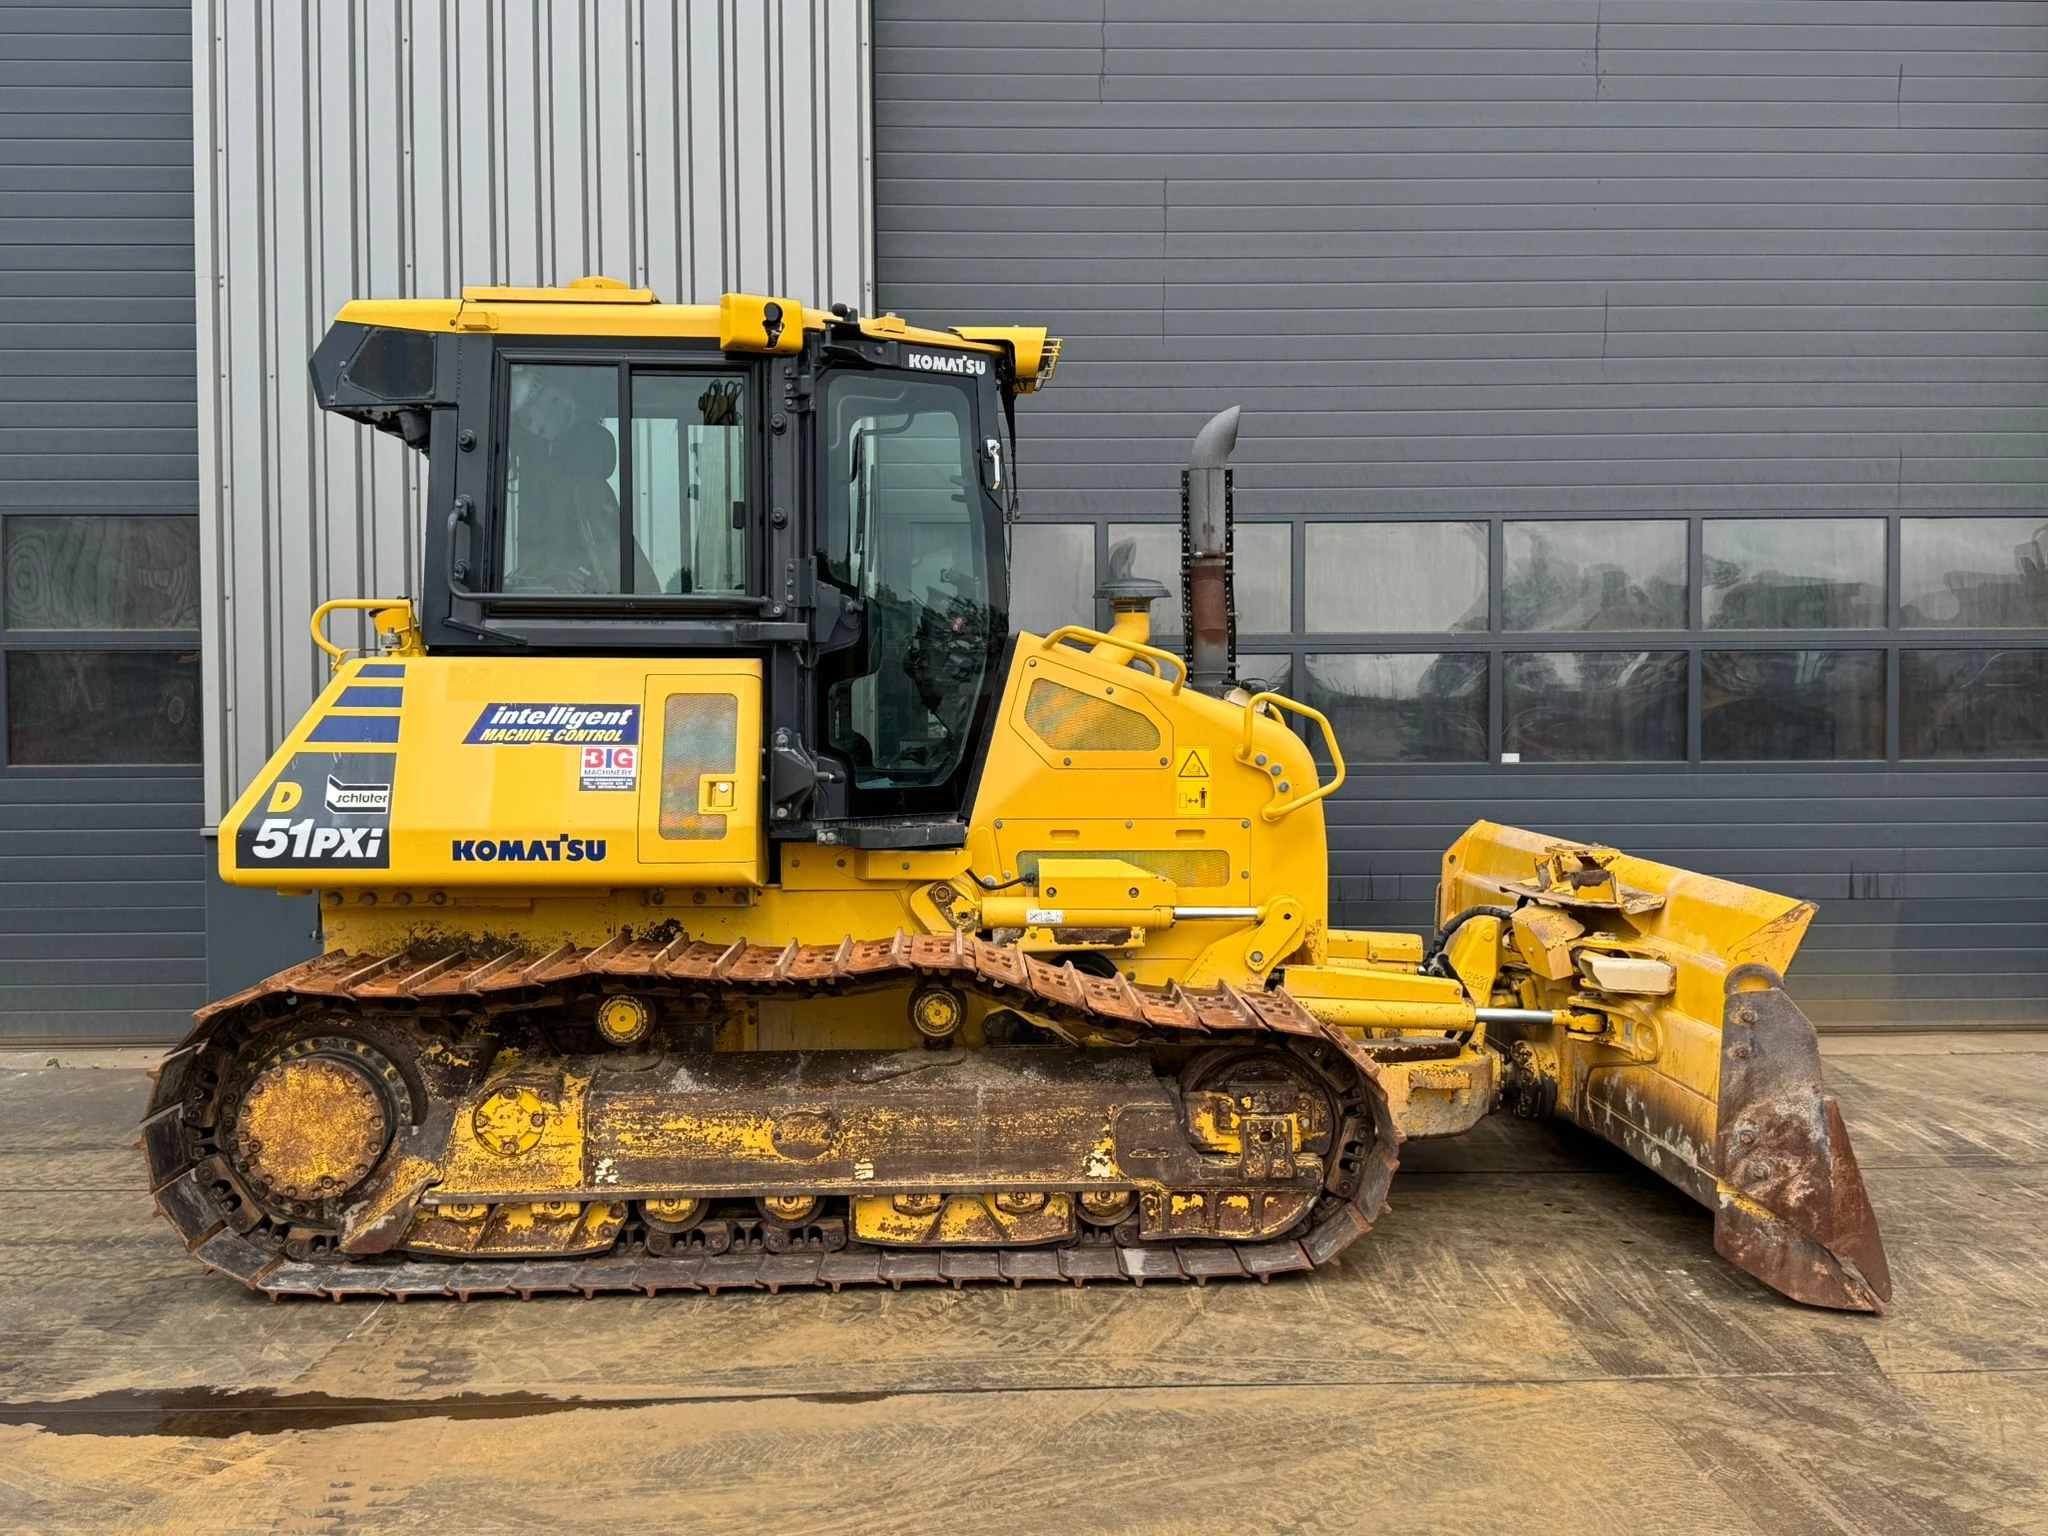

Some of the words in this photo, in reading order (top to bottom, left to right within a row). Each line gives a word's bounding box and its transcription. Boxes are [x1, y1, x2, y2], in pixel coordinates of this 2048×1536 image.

[908, 353, 986, 375] KOMATSU
[490, 706, 633, 729] intelligent
[479, 728, 554, 742] MACHINE
[553, 728, 623, 742] CONTROL
[584, 748, 634, 769] BIG
[267, 781, 303, 813] D
[252, 818, 384, 859] 51PXi
[452, 833, 607, 861] KOMATSU
